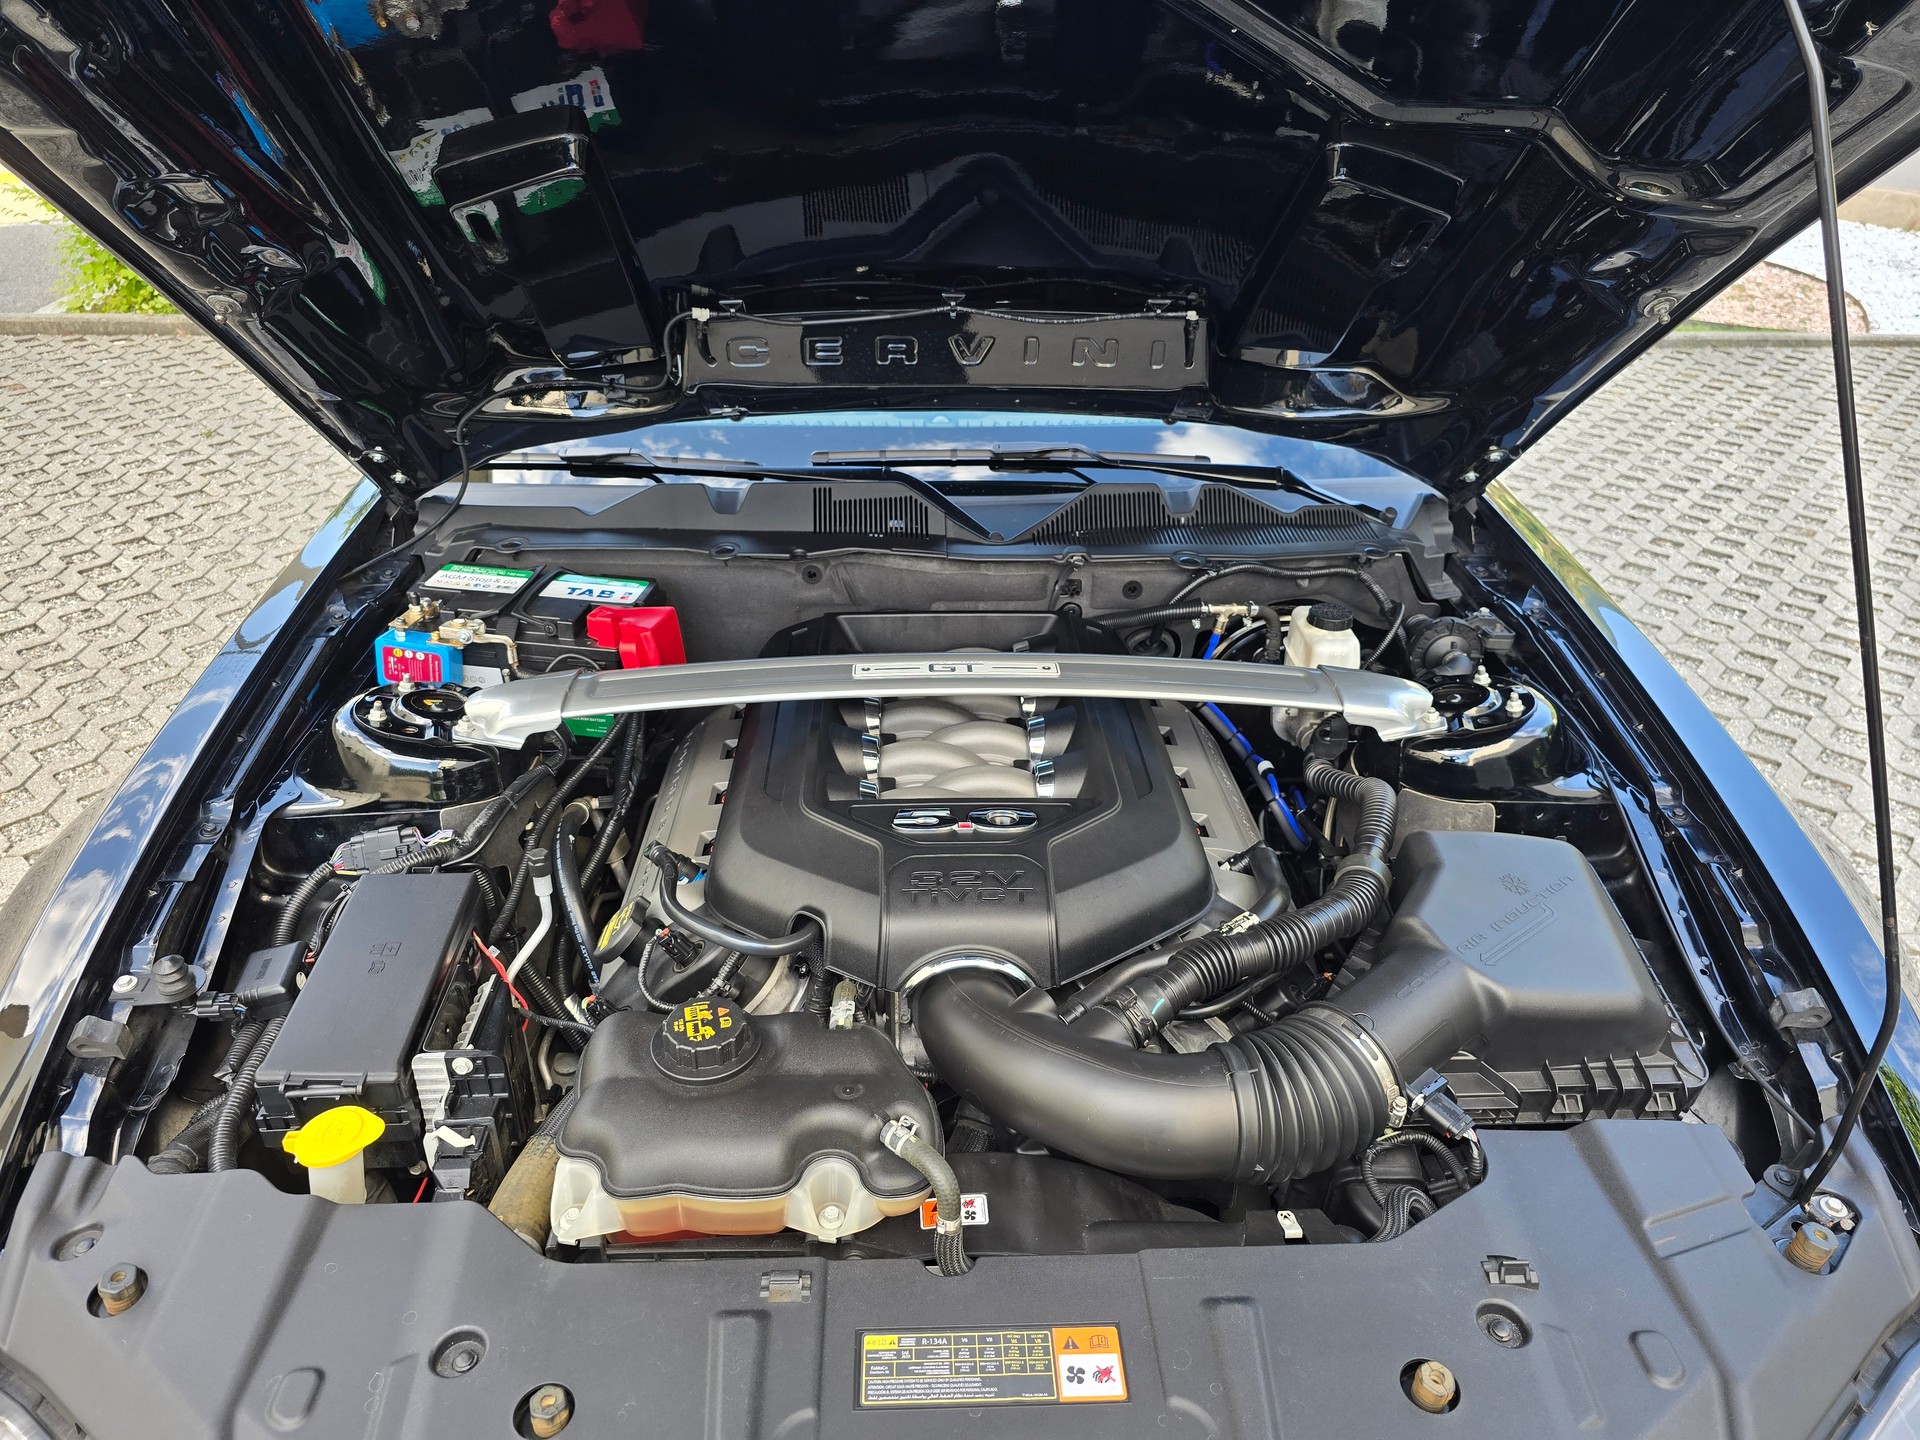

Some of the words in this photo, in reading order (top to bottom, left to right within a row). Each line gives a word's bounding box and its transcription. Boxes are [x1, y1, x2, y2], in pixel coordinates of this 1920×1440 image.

[727, 334, 1166, 369] CERVINI
[468, 575, 492, 584] Stop
[566, 586, 616, 598] TAB
[928, 663, 985, 673] GT
[891, 808, 1038, 834] 5.0
[910, 870, 1025, 887] 32V
[1394, 956, 1450, 1000] COLD
[1456, 932, 1488, 954] AIR
[1490, 872, 1577, 932] INDUCTION
[580, 944, 594, 970] GALAXY
